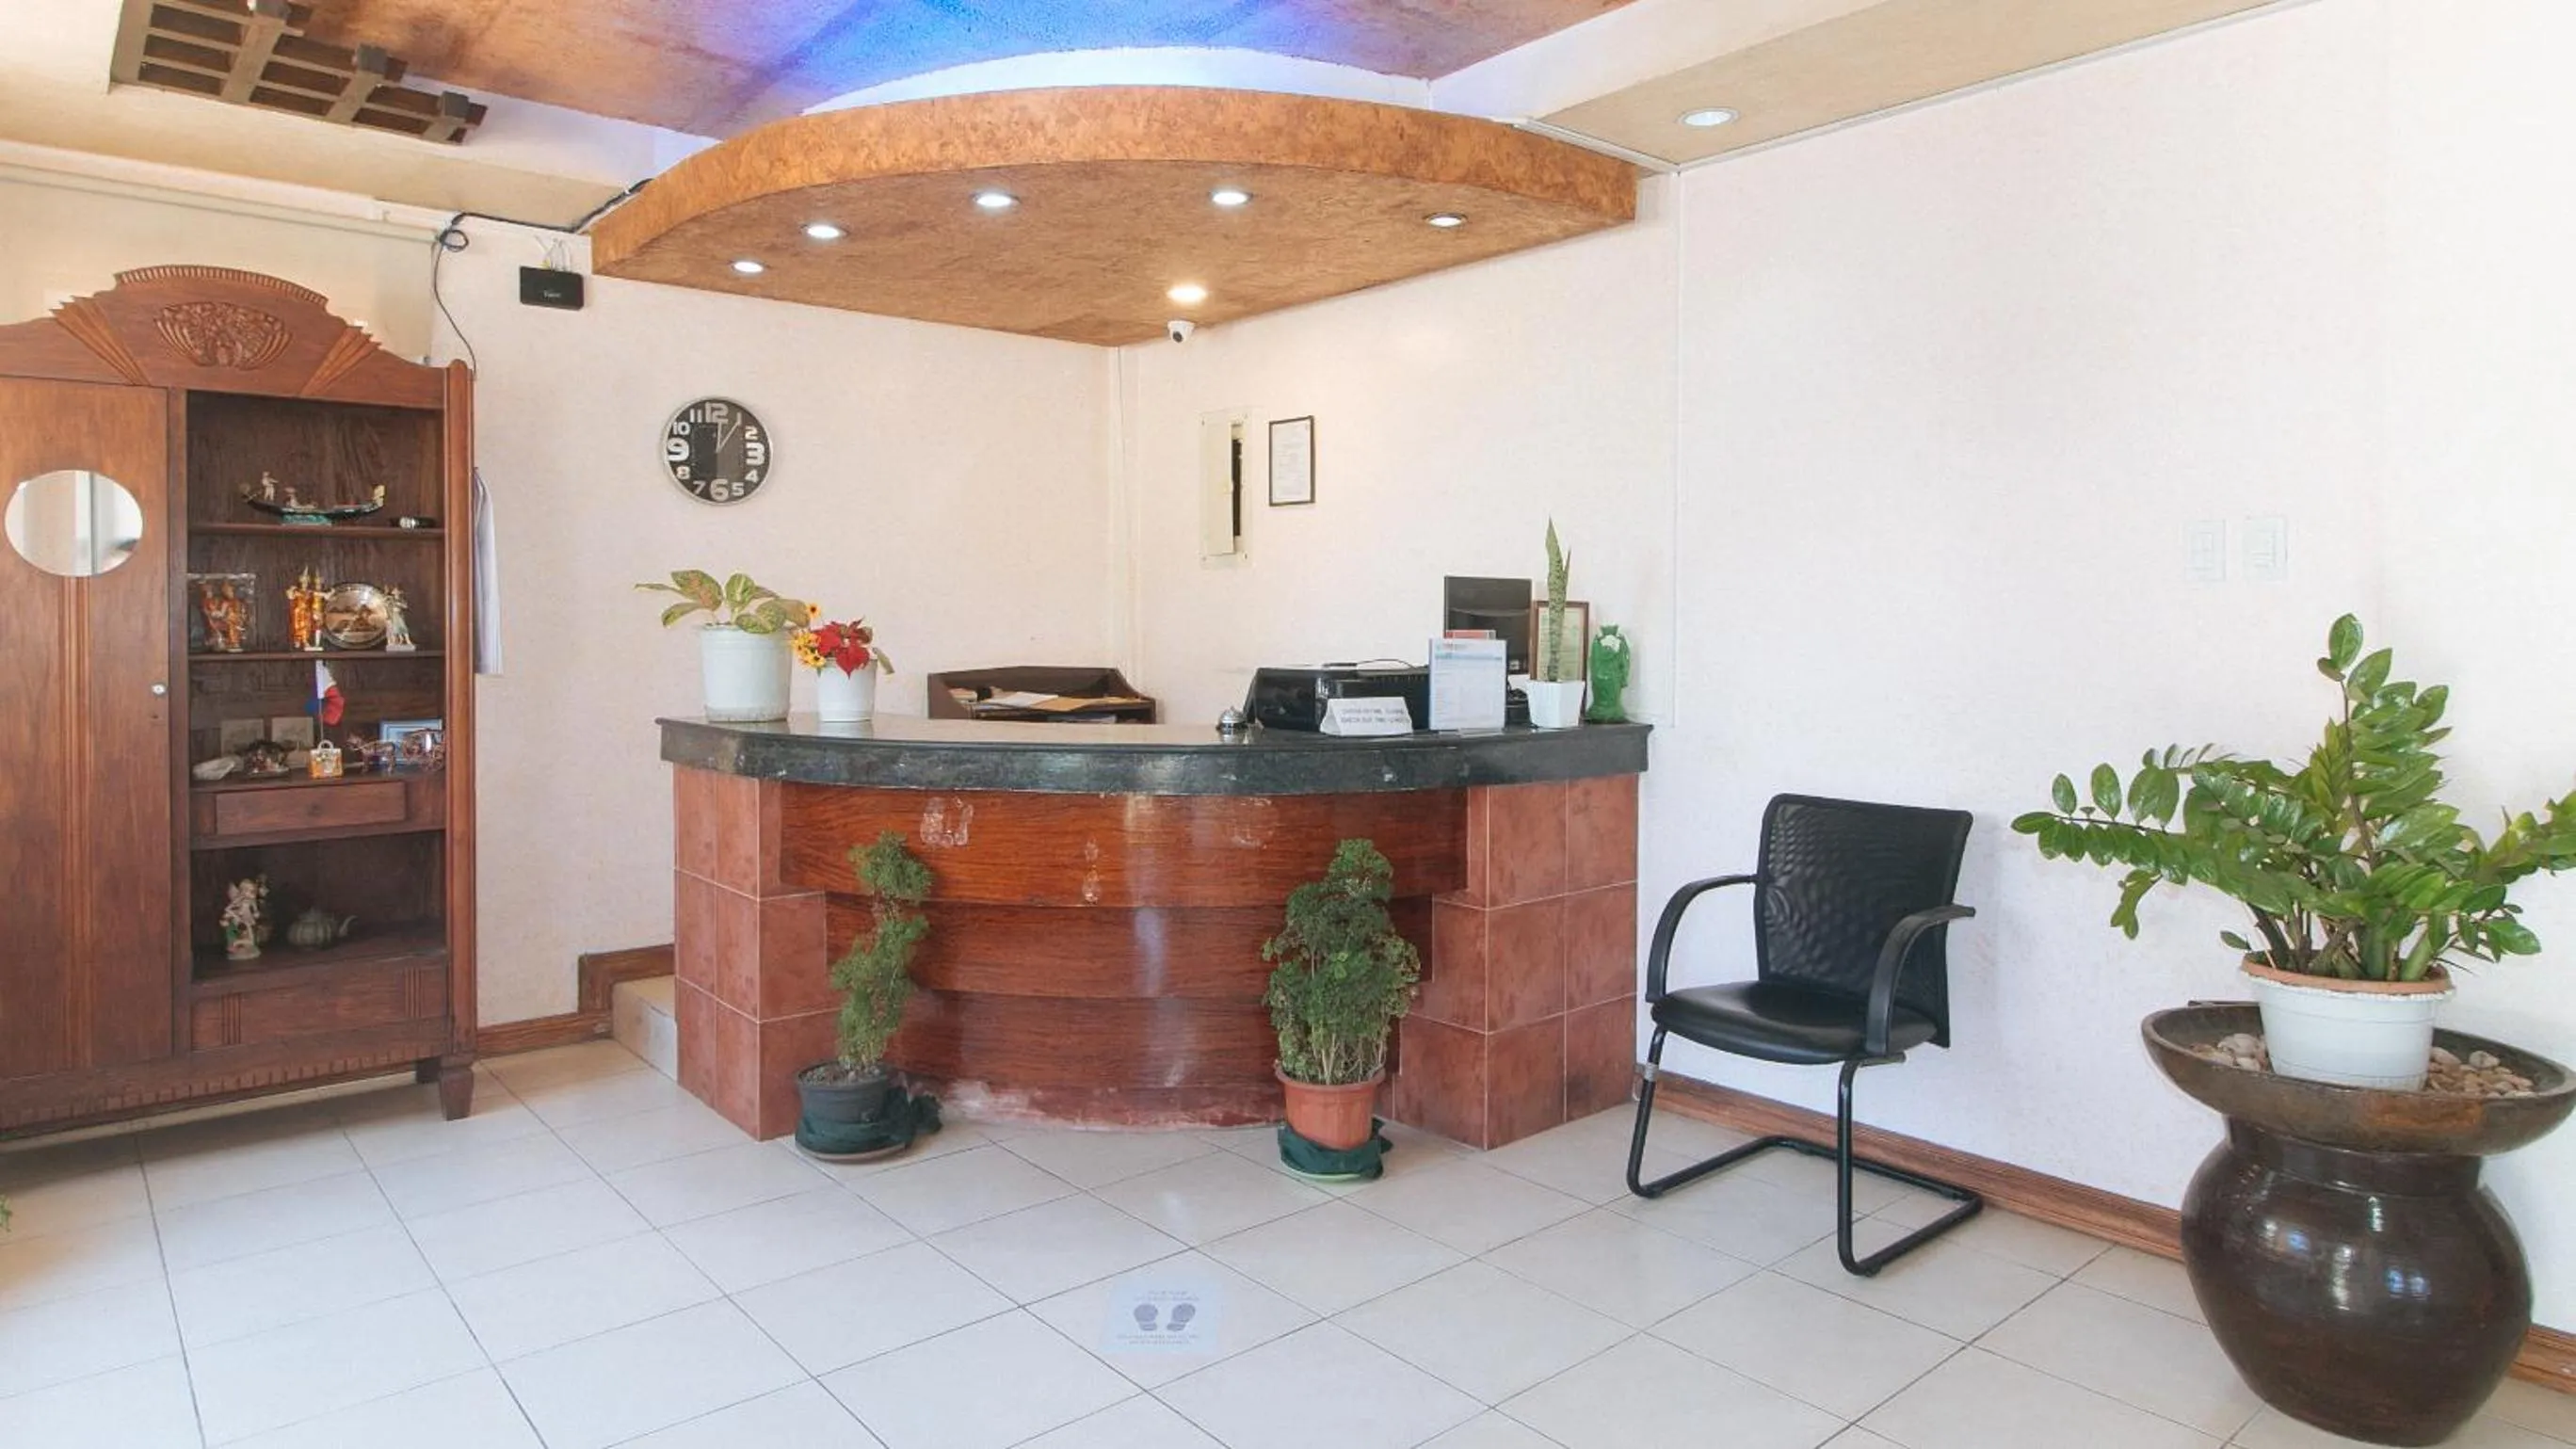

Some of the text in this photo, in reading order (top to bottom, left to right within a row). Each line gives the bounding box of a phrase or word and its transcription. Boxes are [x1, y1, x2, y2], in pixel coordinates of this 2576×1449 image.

[689, 408, 703, 423] 11
[705, 401, 729, 424] 12
[736, 411, 742, 426] 1
[673, 421, 691, 435] 10
[745, 425, 758, 440] 2
[667, 437, 690, 461] 9
[745, 442, 765, 466] 3
[676, 465, 691, 479] 8
[745, 469, 759, 483] 4
[692, 480, 706, 494] 7
[710, 478, 729, 502] 6
[731, 481, 745, 496] 5
